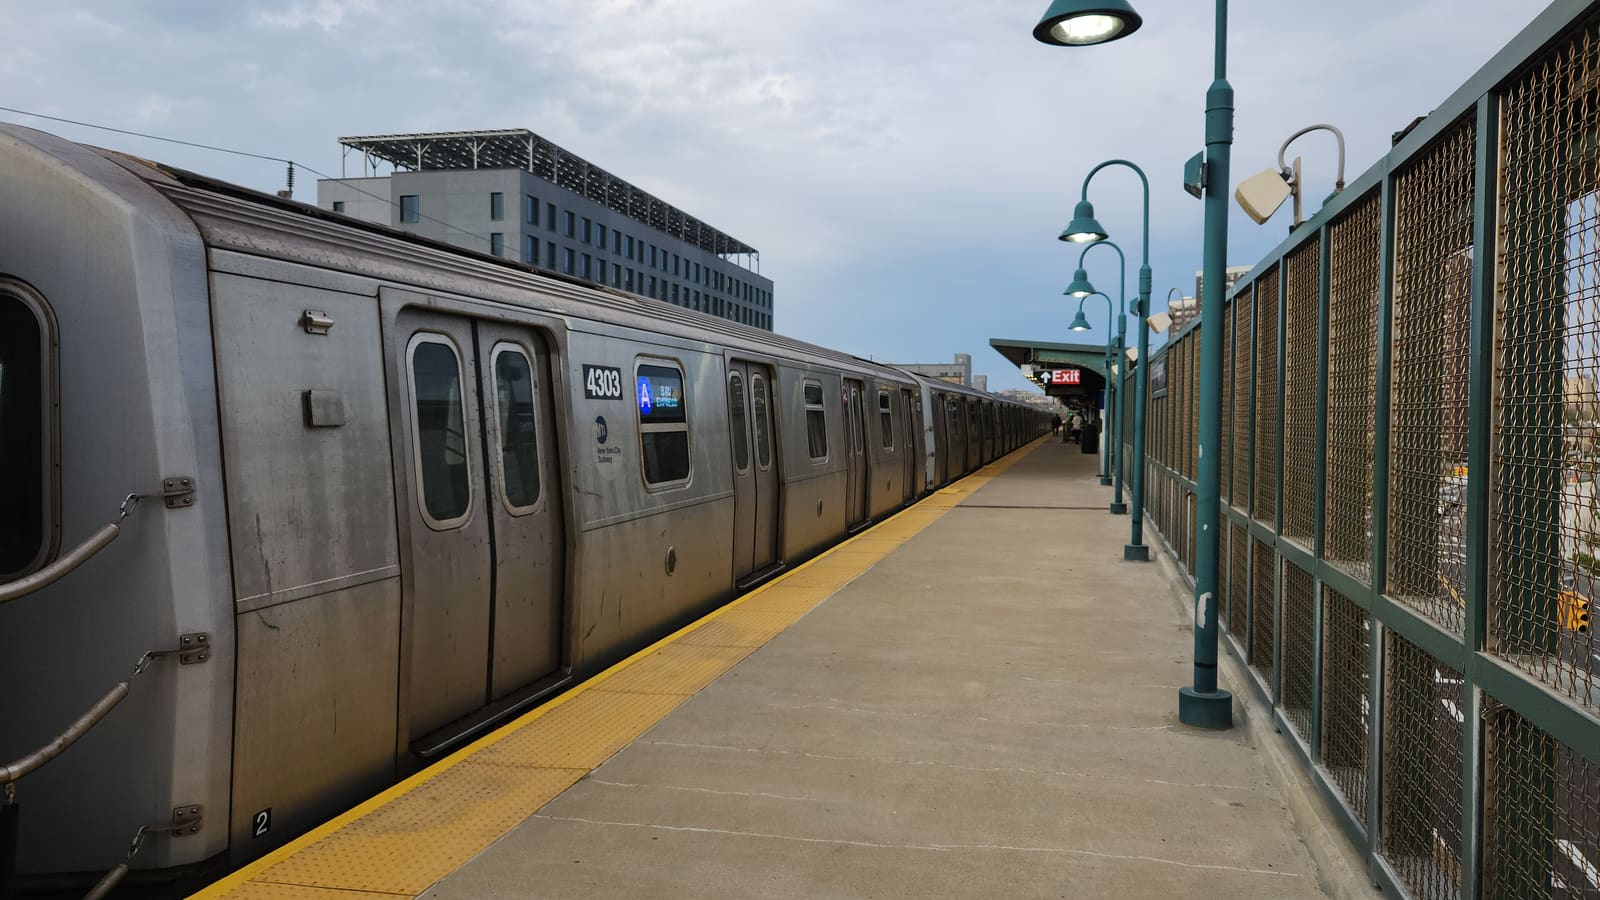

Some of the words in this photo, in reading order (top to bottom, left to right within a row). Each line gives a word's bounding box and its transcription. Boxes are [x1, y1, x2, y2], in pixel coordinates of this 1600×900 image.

[587, 368, 620, 396] 4303
[1052, 370, 1080, 382] Exit
[641, 384, 651, 407] A
[256, 811, 268, 836] 2
